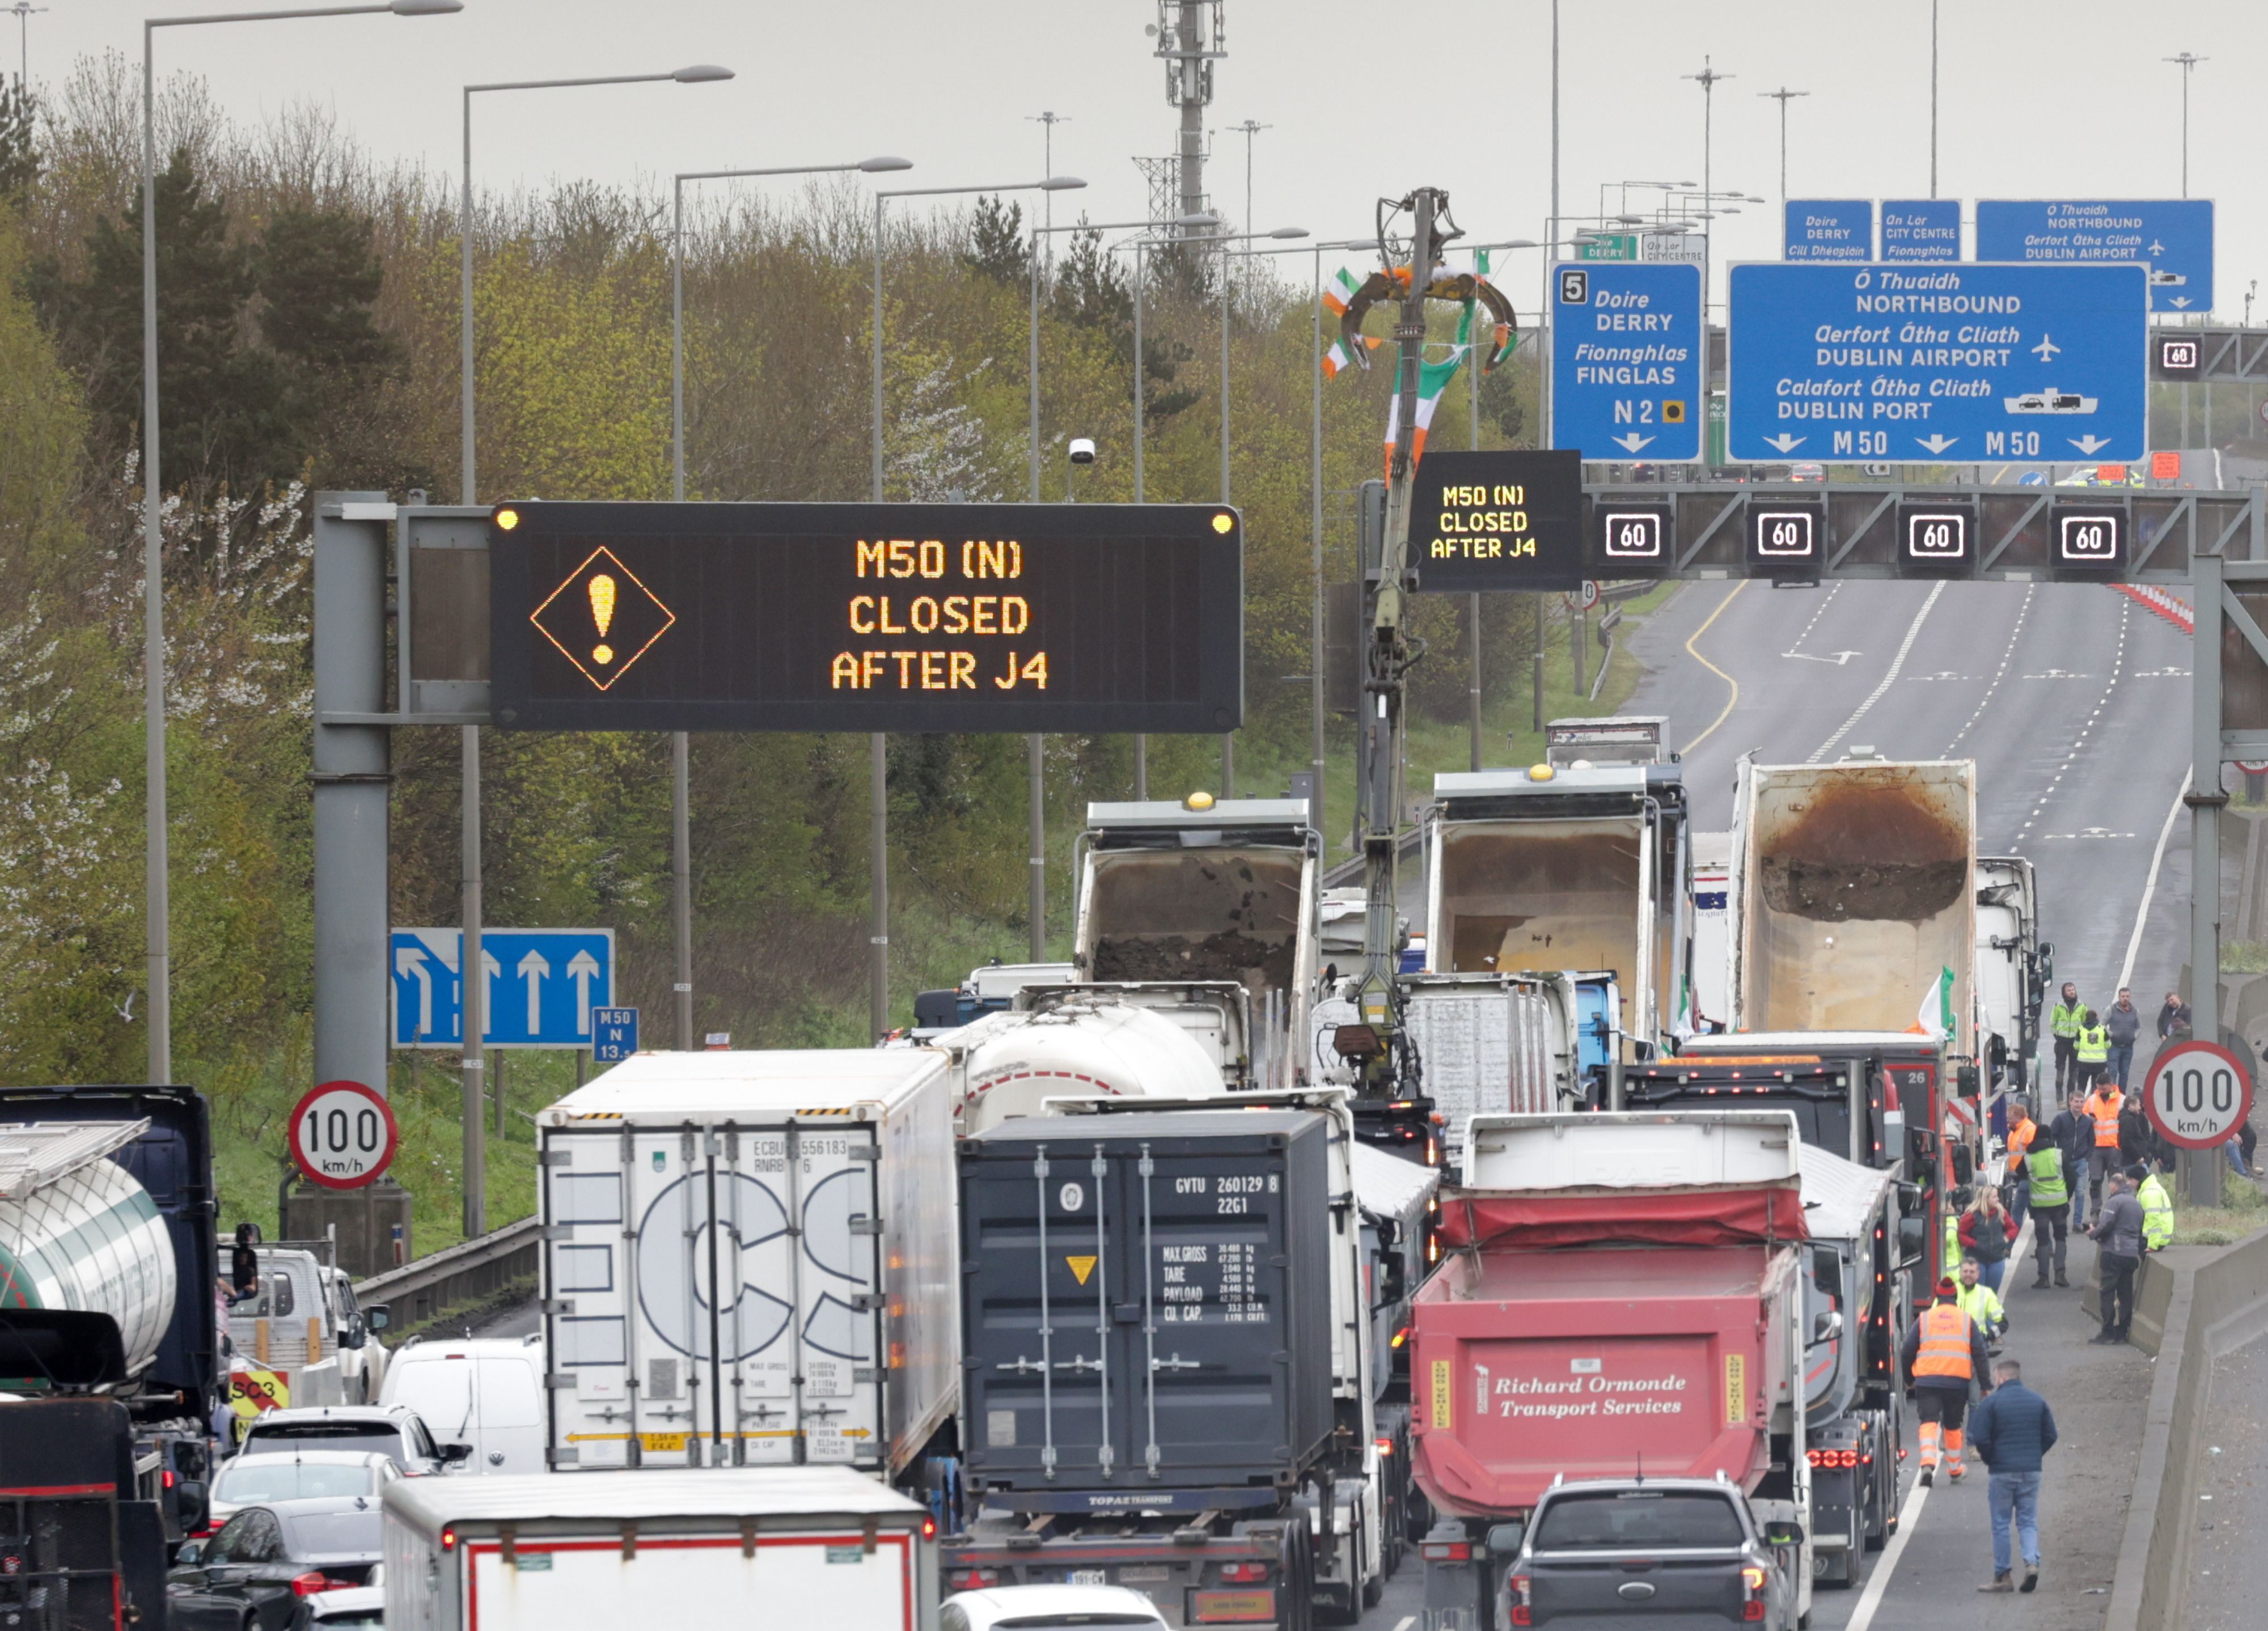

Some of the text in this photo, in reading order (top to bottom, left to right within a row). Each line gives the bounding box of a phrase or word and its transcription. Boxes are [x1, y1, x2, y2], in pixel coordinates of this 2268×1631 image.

[2062, 205, 2108, 215] Thuaidh
[1805, 215, 1837, 226] Doire
[2048, 218, 2142, 228] NORTHBOUND
[1807, 229, 1850, 239] DERRY
[1886, 229, 1955, 239] CITY CENTRE
[2106, 235, 2141, 245] Cliath
[1789, 245, 1808, 256] Cill
[1888, 245, 1953, 257] Fionnghlas
[2026, 249, 2136, 259] DUBLIN AIRPORT
[1565, 276, 1582, 299] 5
[1854, 269, 1960, 289] Ó Thuaidh
[1594, 291, 1649, 308] Doire
[1856, 295, 2021, 314] NORTHBOUND
[1597, 314, 1673, 331] DERRY
[1957, 325, 2020, 343] Cliath
[1575, 344, 1687, 366] Fionnghlas
[1817, 349, 2011, 366] DUBLIN AIRPORT
[1577, 367, 1675, 385] FINGLAS
[1776, 379, 1862, 397] Calafort
[1929, 379, 1991, 397] Cliath
[1778, 402, 1932, 420] DUBLIN PORT
[1443, 486, 1524, 506] M50 (N)
[1440, 512, 1527, 532] CLOSED
[1620, 523, 1645, 547] 60
[1772, 523, 1797, 546] 60
[1924, 524, 1949, 548] 60
[2076, 526, 2101, 549] 60
[1431, 539, 1535, 558] AFTER J4
[857, 540, 1021, 578] M50 (N)
[850, 596, 1028, 634] CLOSED
[832, 651, 1047, 689] AFTER J4
[611, 1029, 621, 1041] N
[1909, 1073, 1925, 1084] 26
[2163, 1069, 2232, 1112] 100
[308, 1109, 377, 1153] 100
[2178, 1117, 2218, 1133] km/h
[754, 1141, 847, 1155] ECBU 556183
[323, 1158, 363, 1173] km/h
[803, 1159, 811, 1173] 6
[1176, 1176, 1276, 1193] GVTU 260129 8
[1217, 1197, 1247, 1213] 22G1
[1246, 1244, 1254, 1254] kg
[1246, 1254, 1253, 1263] lb
[1164, 1266, 1186, 1282] TARE
[1246, 1264, 1254, 1274] kg
[1246, 1274, 1253, 1283] lb
[1163, 1286, 1203, 1302] PAYLOAD
[1246, 1284, 1255, 1294] kg
[1164, 1306, 1178, 1321] CU.
[1183, 1306, 1202, 1321] CAP.
[232, 1382, 275, 1399] SC3
[1495, 1374, 1686, 1394] Richard Ormonde
[1500, 1398, 1682, 1419] Transport Services
